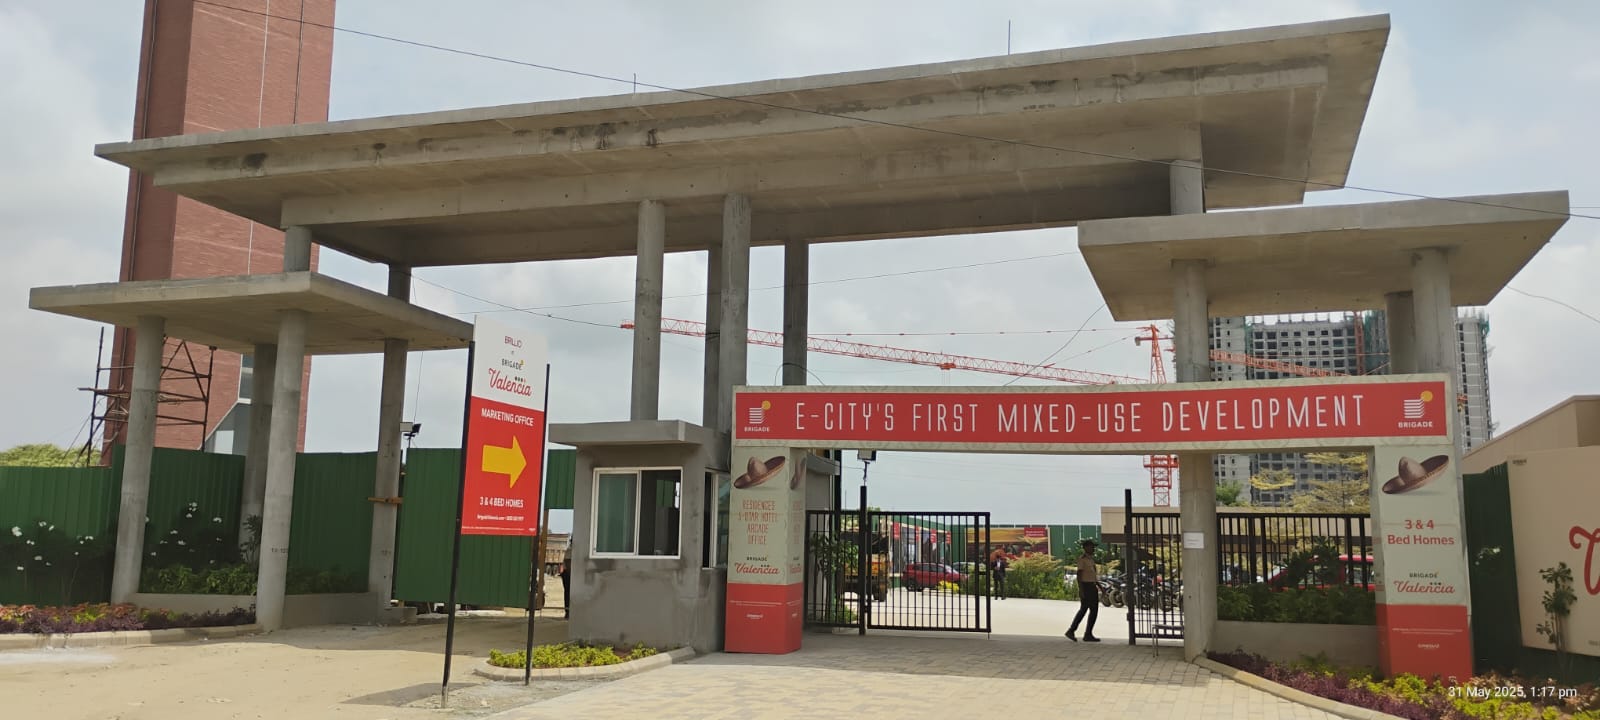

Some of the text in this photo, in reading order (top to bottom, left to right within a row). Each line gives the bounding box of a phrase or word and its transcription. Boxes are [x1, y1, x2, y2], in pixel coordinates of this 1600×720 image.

[502, 358, 522, 370] BRIGADE
[488, 368, 532, 396] Valencia
[481, 408, 534, 426] MARKETING OFFICE
[796, 394, 1364, 432] E-CITY'S FIRST MIXED-USE DEVELOPMENT
[480, 496, 484, 506] 3
[489, 498, 493, 506] 4
[494, 498, 504, 506] BED
[506, 498, 524, 508] HOMES
[1404, 520, 1434, 530] 3 & 4
[1388, 534, 1410, 545] Bed
[1414, 534, 1454, 545] Homes
[734, 562, 780, 574] Valencia
[1394, 580, 1456, 594] Valencia
